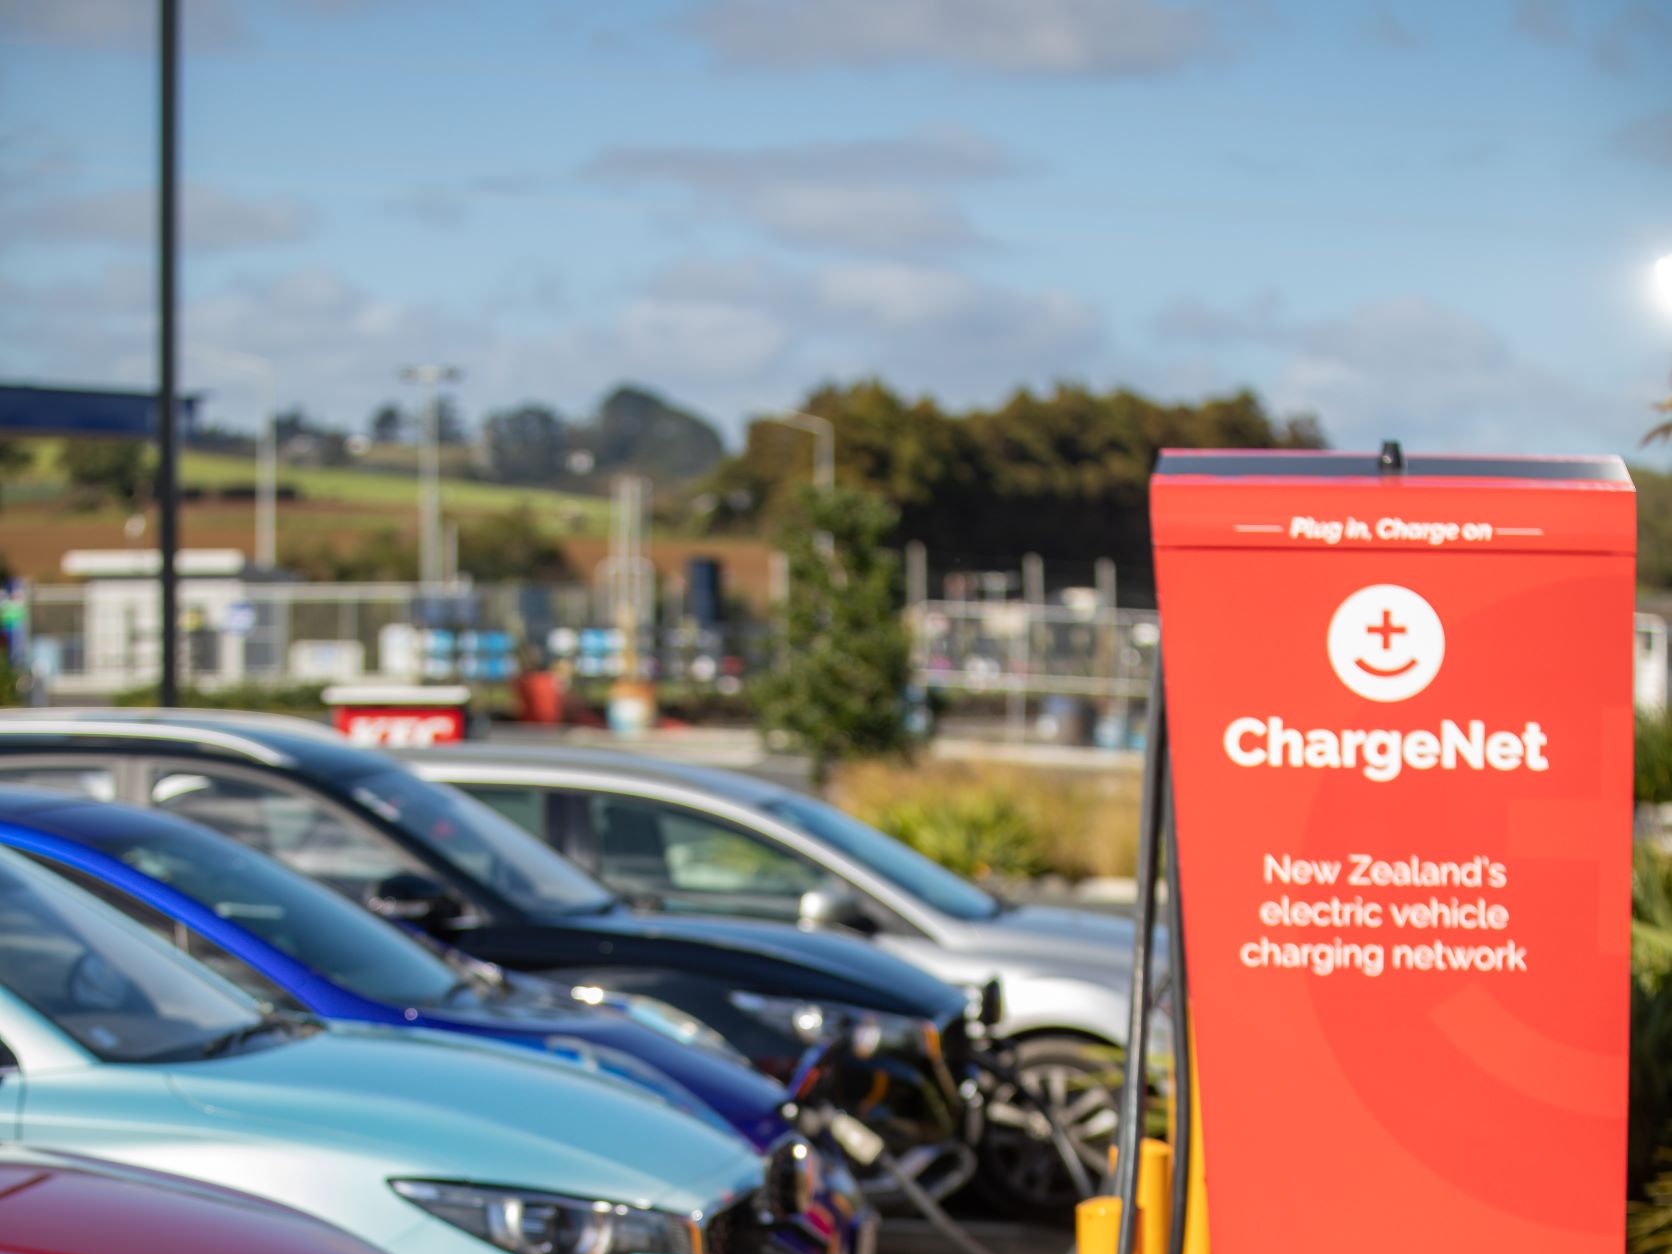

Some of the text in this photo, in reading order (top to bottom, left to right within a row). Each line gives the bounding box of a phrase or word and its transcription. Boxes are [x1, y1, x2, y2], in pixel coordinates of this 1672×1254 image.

[1289, 516, 1343, 544] Plug
[1375, 517, 1460, 545] Charge
[1461, 522, 1493, 541] on
[1223, 716, 1549, 782] ChargeNet
[1264, 853, 1507, 888] New Zealand's
[1259, 894, 1509, 930] electric vehicle
[1239, 936, 1527, 977] charging network
